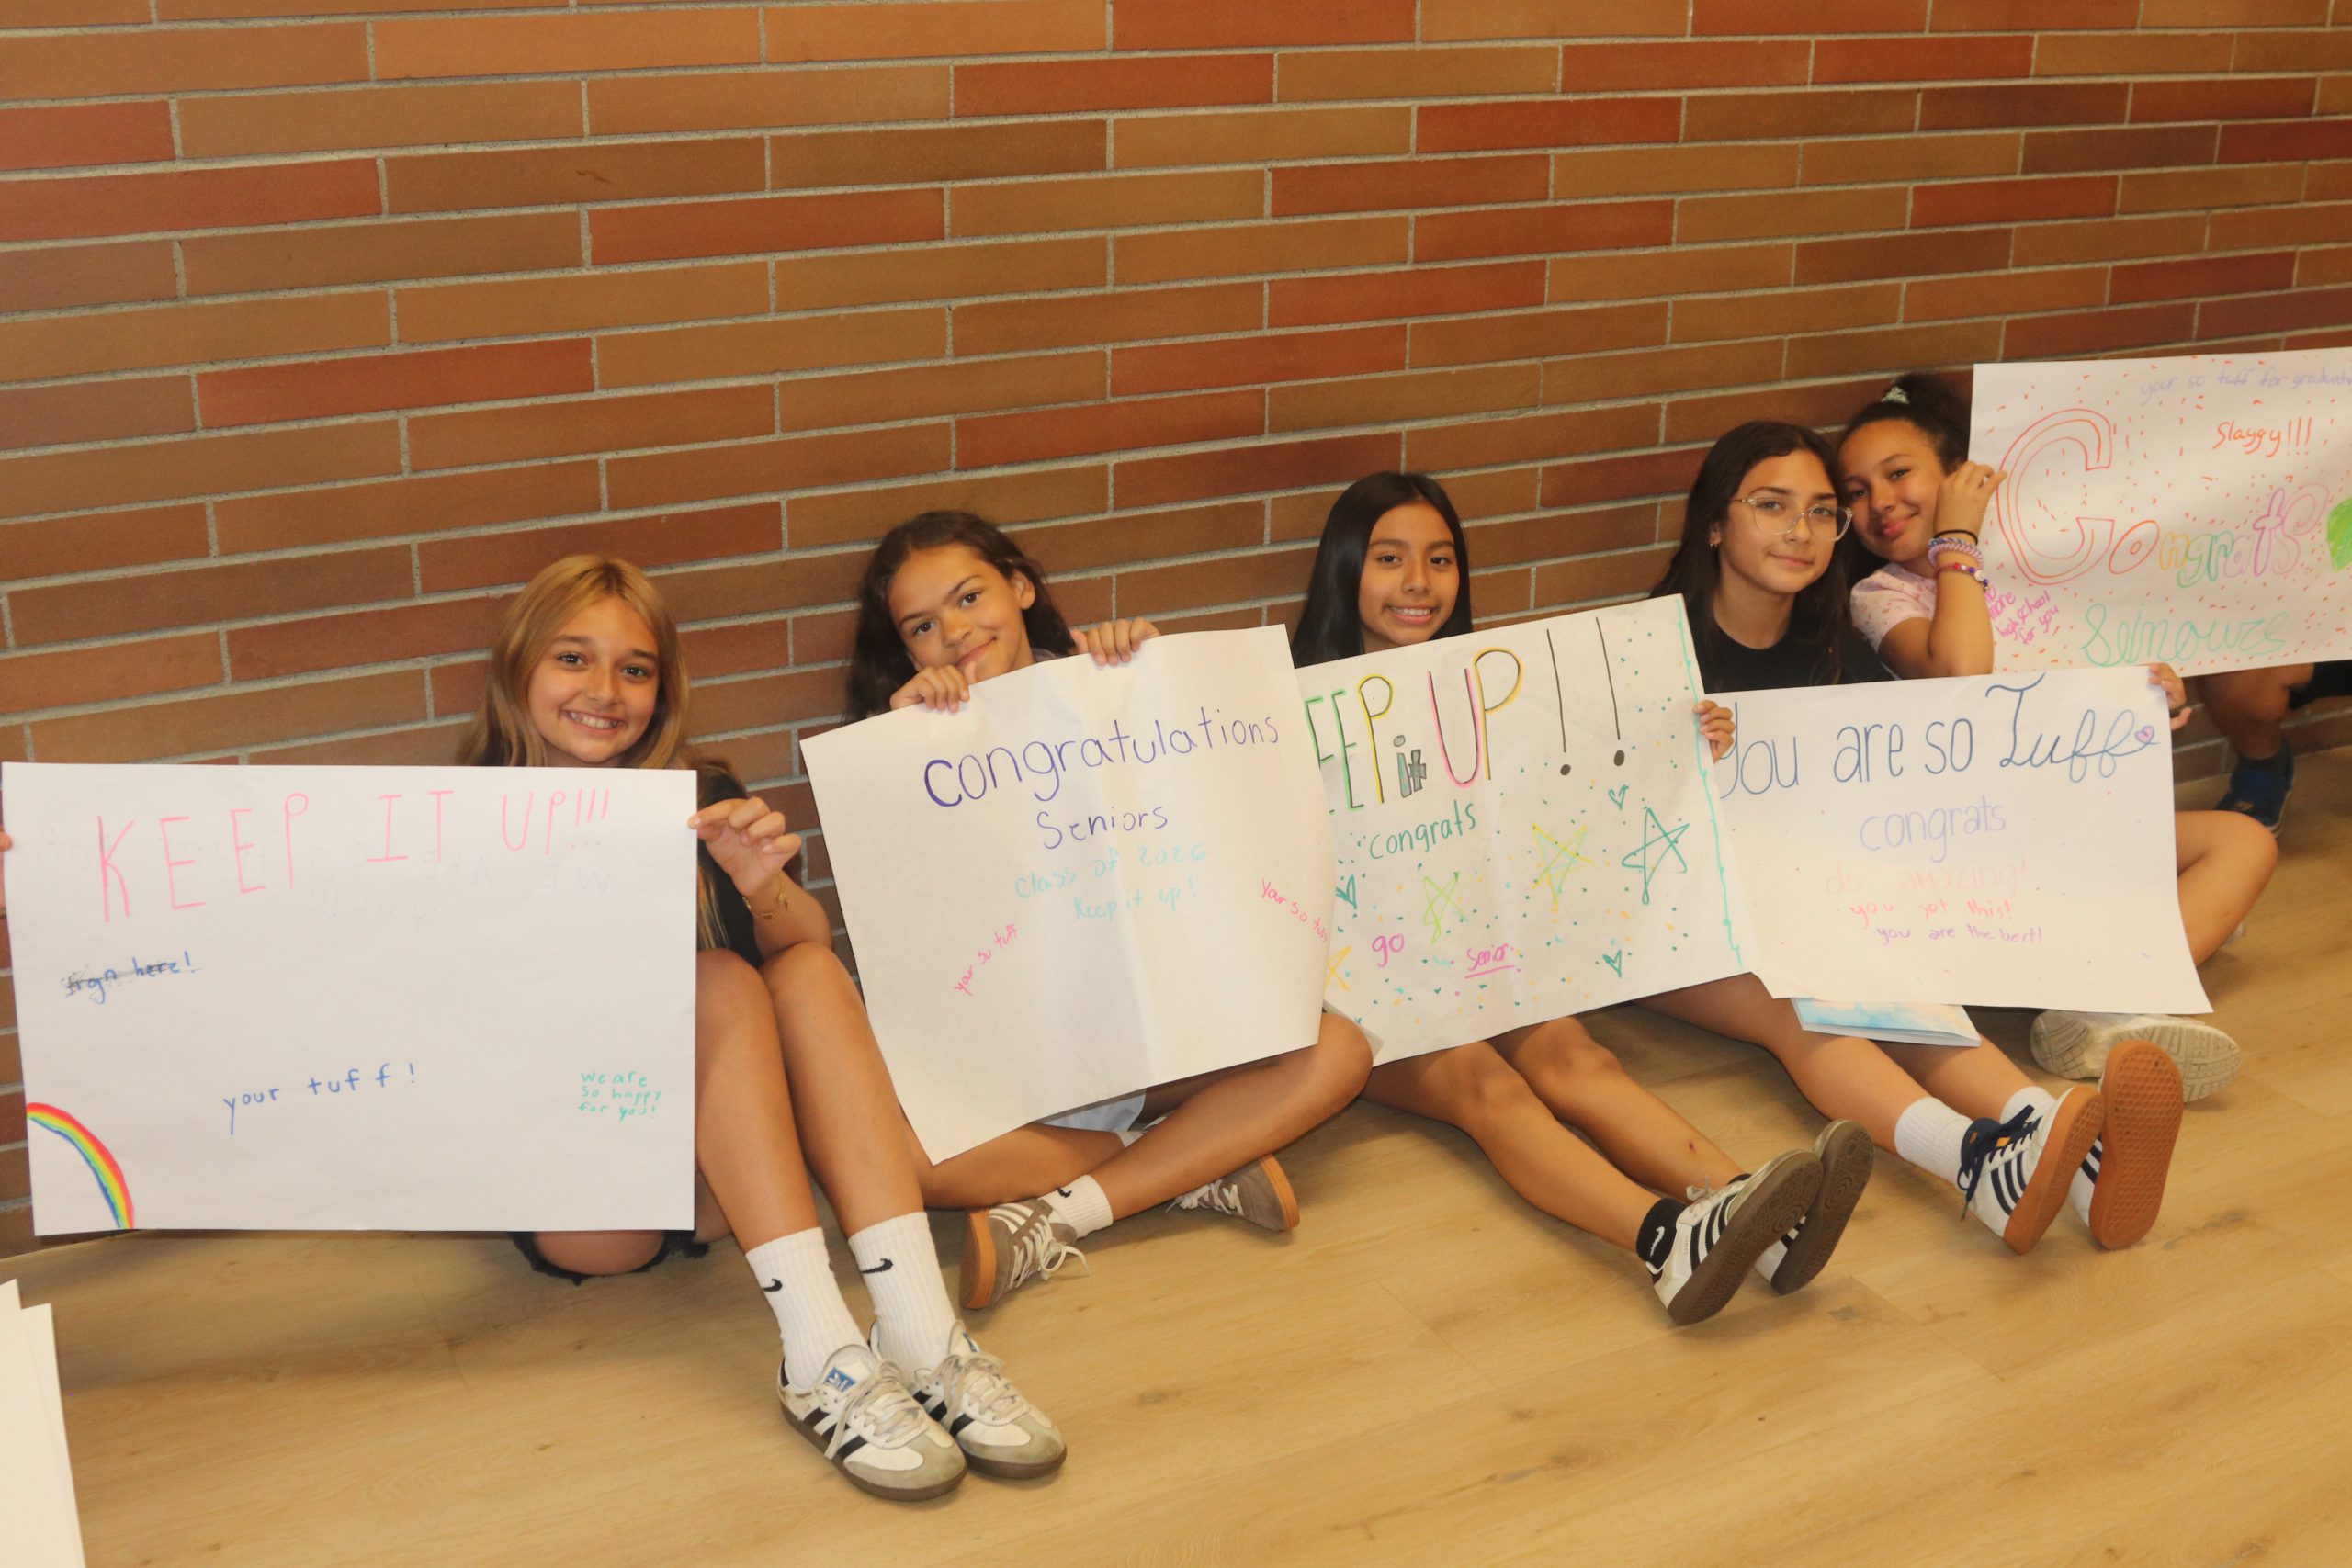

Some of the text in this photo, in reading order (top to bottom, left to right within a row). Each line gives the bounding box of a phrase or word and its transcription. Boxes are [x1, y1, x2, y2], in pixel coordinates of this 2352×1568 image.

[1304, 673, 1395, 814] EEP
[1393, 734, 1427, 798] it
[1833, 723, 1904, 783] are
[97, 792, 309, 923] KEEP
[368, 790, 455, 863] IT
[1091, 846, 1118, 877] of
[1849, 902, 1894, 930] you
[1371, 932, 1406, 969] go
[1876, 926, 1912, 947] you
[1928, 927, 1957, 941] are
[1966, 923, 1996, 941] the
[612, 1070, 648, 1088] are
[222, 1084, 281, 1135] your
[611, 1088, 662, 1105] happy
